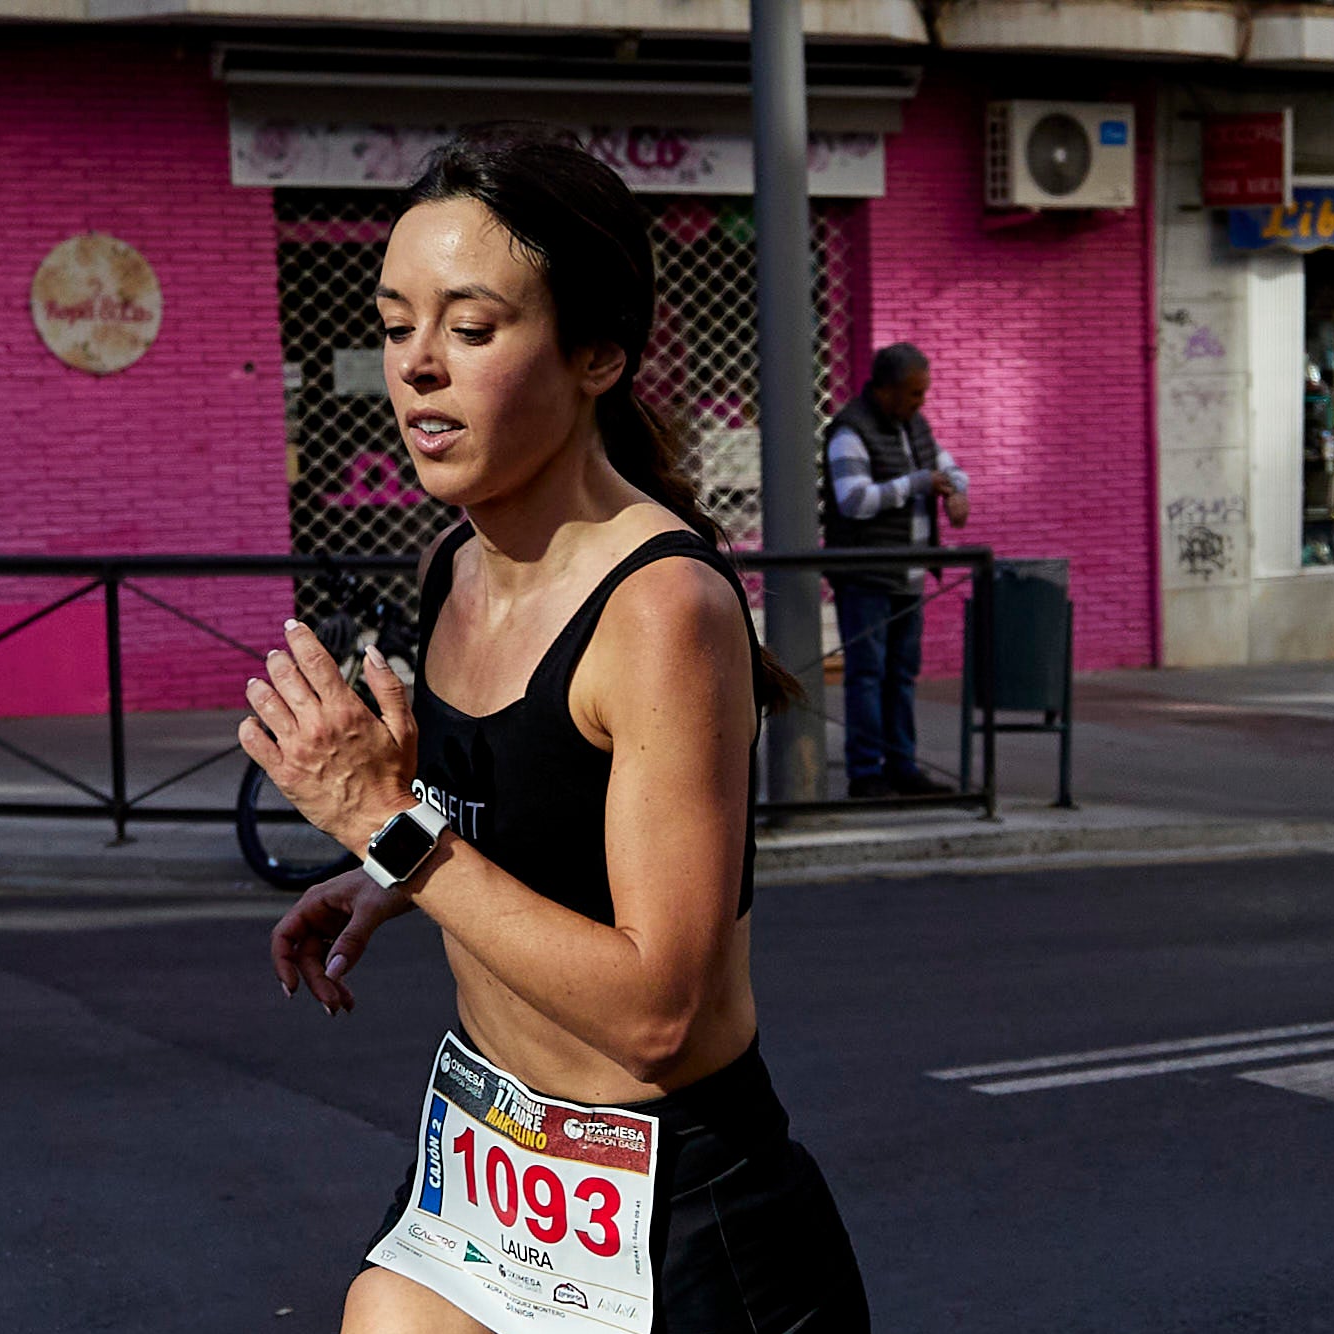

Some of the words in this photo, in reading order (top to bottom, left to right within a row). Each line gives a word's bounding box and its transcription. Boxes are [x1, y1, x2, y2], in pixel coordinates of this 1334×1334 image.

[451, 1059, 486, 1090] OXIMESA
[432, 1118, 442, 1133] 2
[485, 1106, 548, 1150] MARCELINO
[508, 1103, 544, 1132] PADRE
[427, 1135, 441, 1189] CAJÓN
[618, 1140, 646, 1152] GASES
[453, 1126, 622, 1257] 1093
[500, 1234, 554, 1271] LAURA
